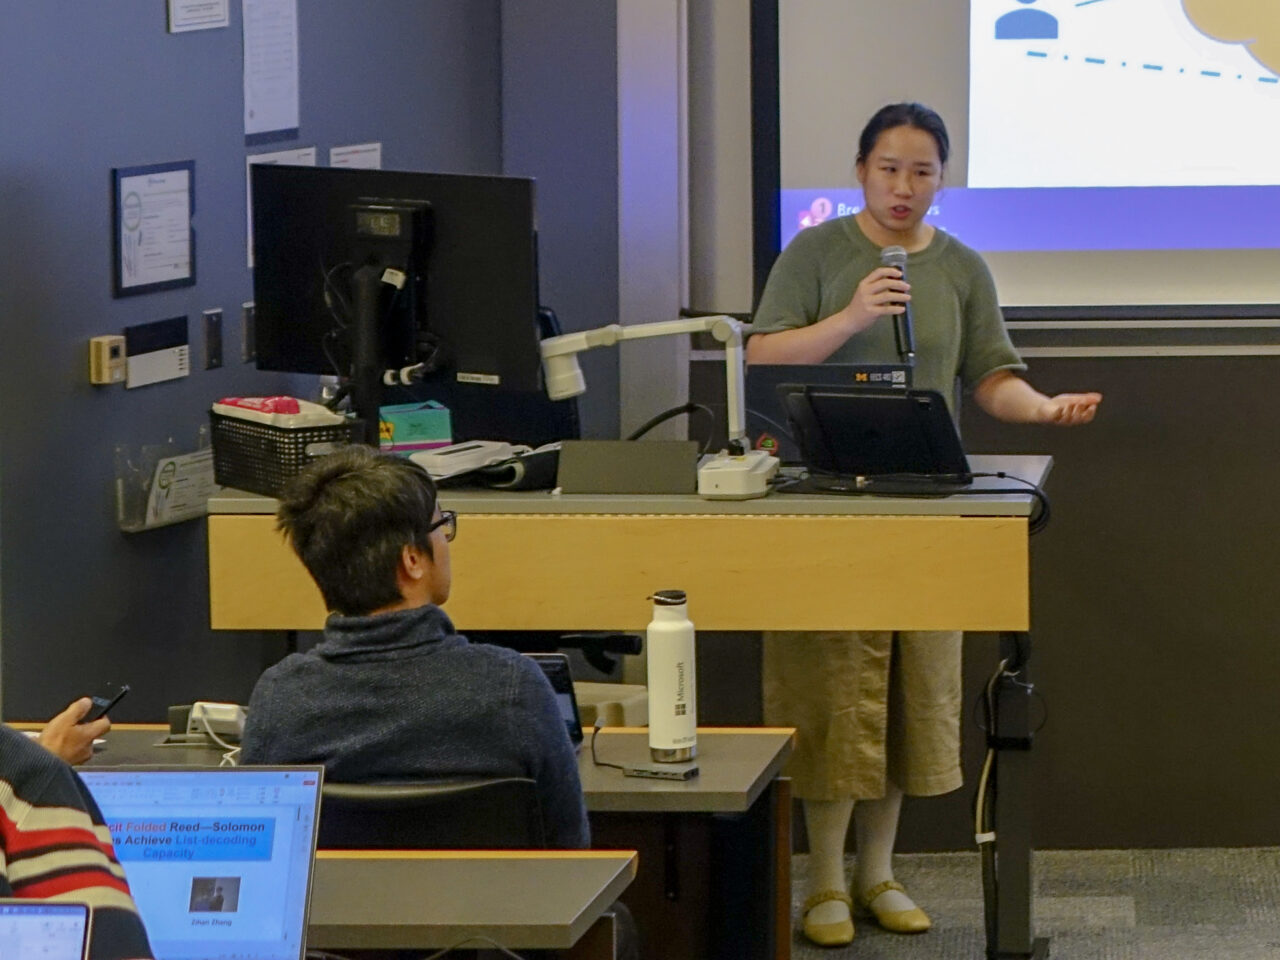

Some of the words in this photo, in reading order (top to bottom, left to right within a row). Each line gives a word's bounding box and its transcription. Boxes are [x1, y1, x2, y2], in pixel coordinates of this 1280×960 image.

[676, 661, 685, 702] Microsoft
[126, 821, 166, 833] Folded
[125, 834, 172, 846] Achieve
[143, 847, 195, 861] Capacity
